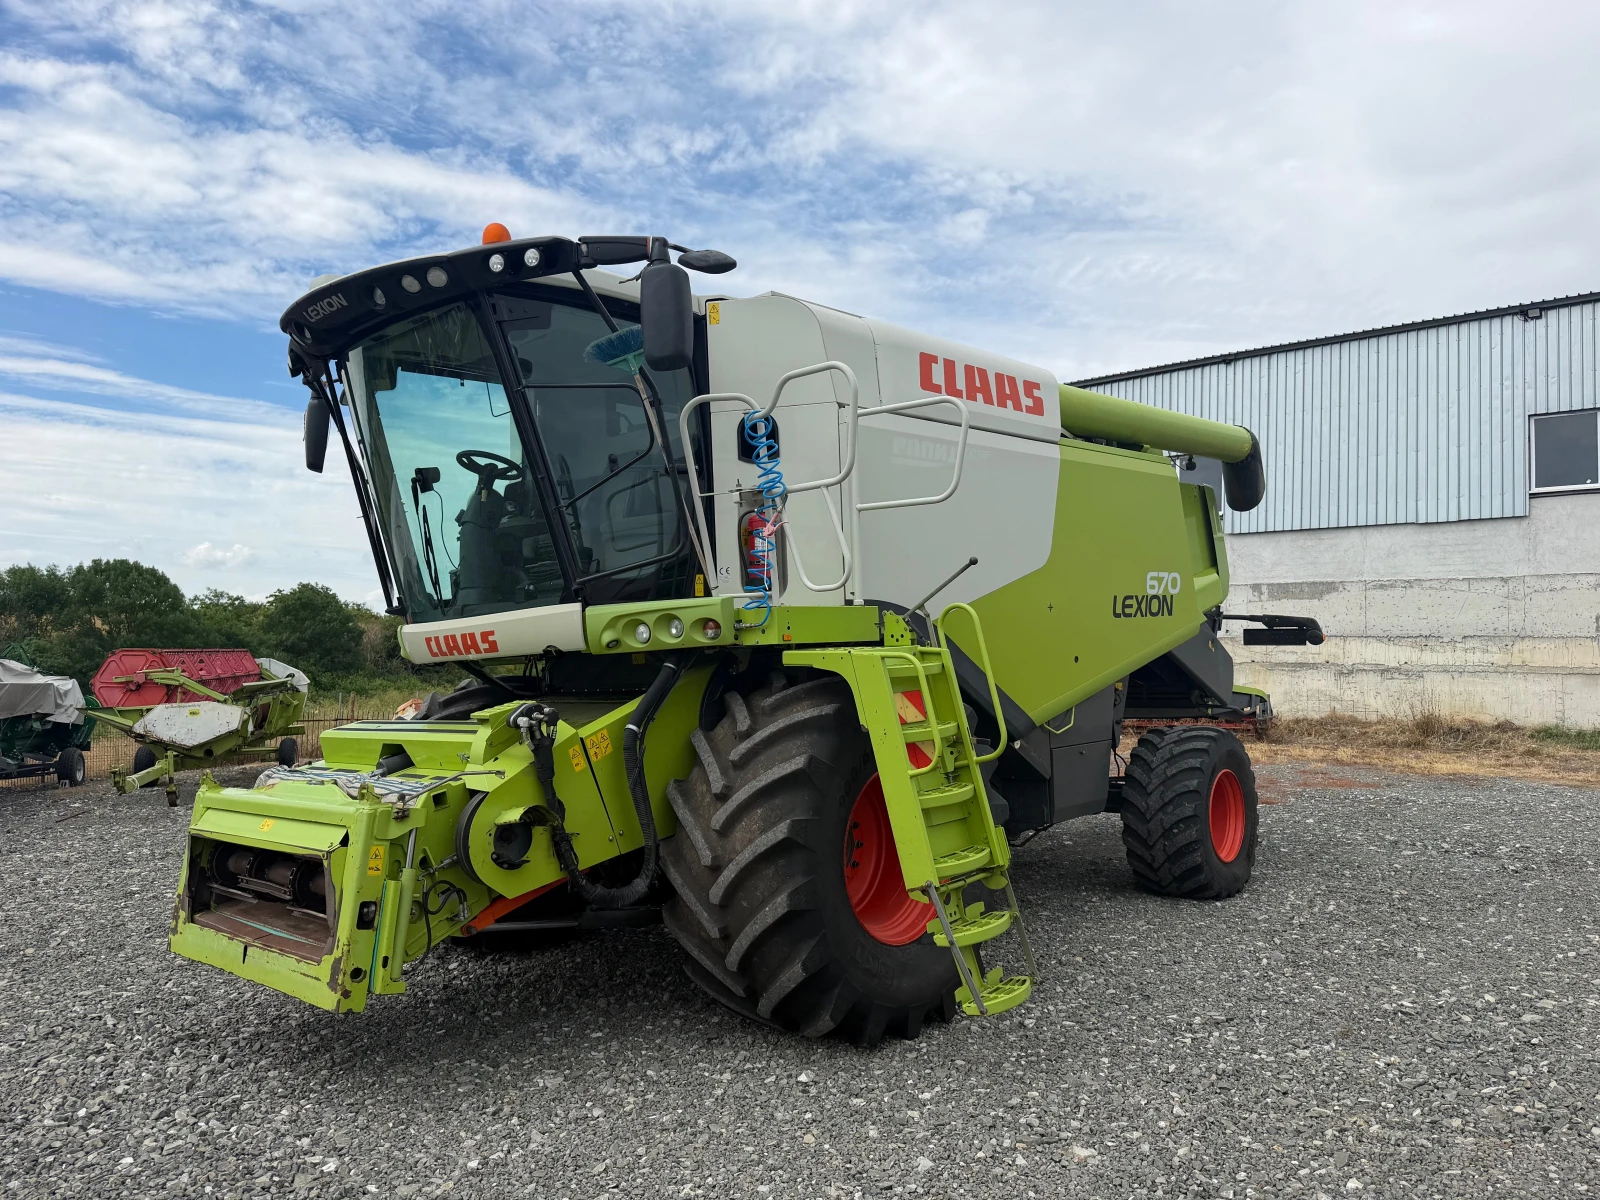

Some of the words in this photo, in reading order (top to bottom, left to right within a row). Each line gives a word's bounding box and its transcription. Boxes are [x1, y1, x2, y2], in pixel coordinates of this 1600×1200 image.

[303, 292, 349, 322] LEXION
[918, 352, 1044, 417] CLAAS
[1146, 571, 1181, 595] 670
[1112, 594, 1174, 619] LEXION
[424, 630, 500, 658] CLAAS
